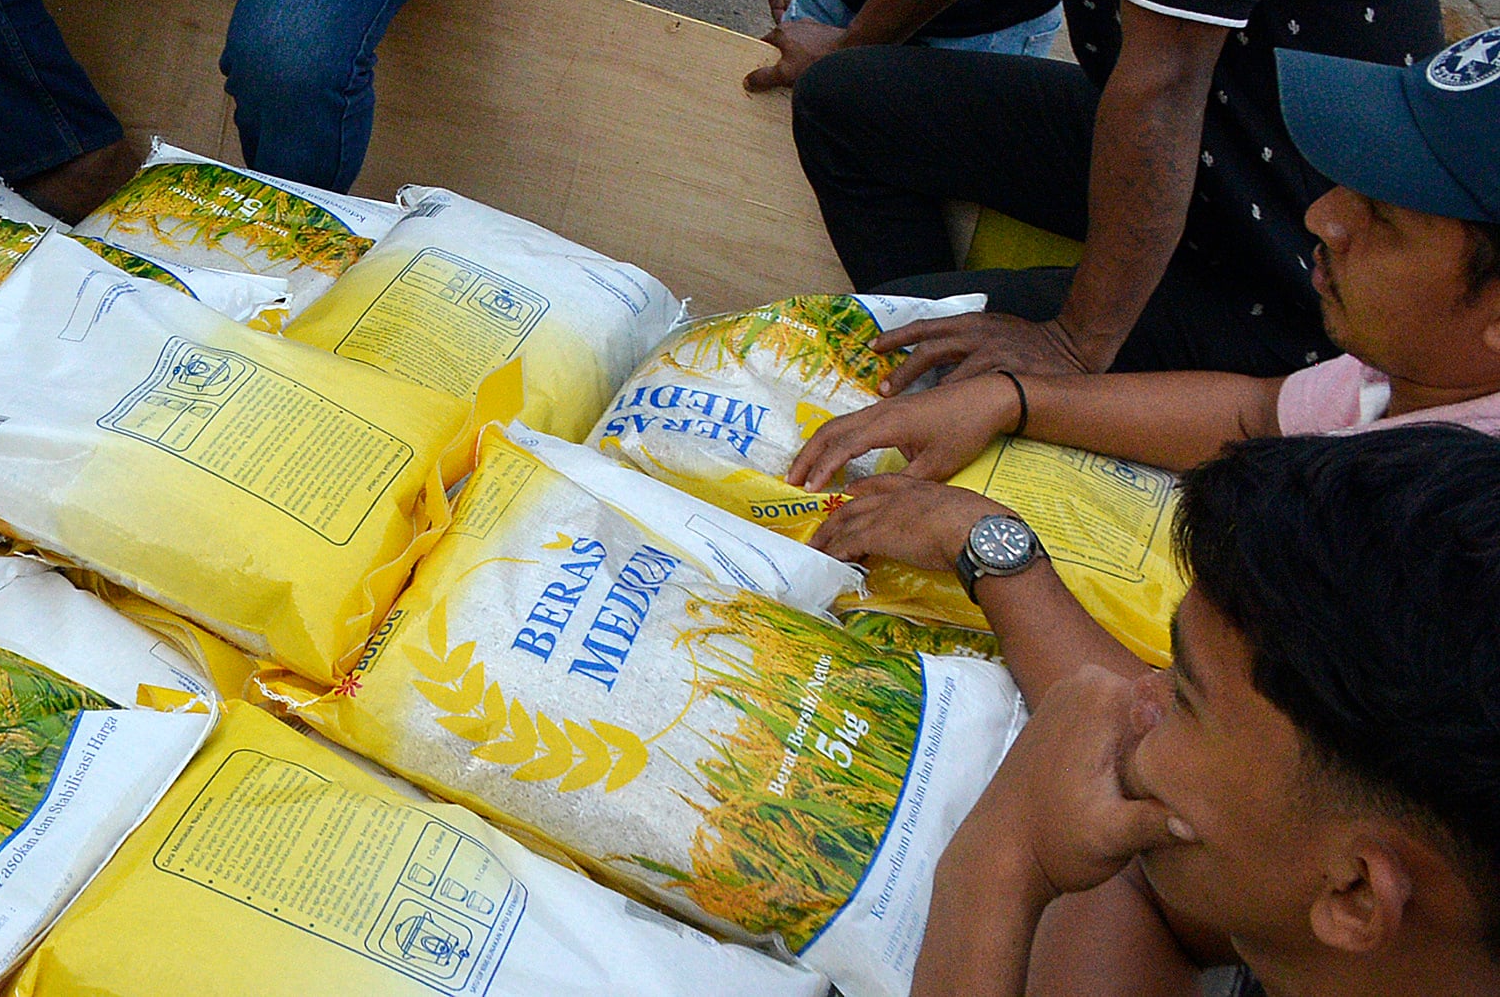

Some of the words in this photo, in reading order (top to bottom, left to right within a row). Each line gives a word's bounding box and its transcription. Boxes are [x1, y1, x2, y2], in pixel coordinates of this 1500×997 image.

[602, 411, 756, 459] BERAS
[613, 381, 770, 436] MEDI
[749, 501, 819, 517] BULOG
[509, 531, 610, 665] BERAS
[767, 746, 799, 797] Berat
[786, 651, 833, 748] Bersih/Netto:
[922, 704, 951, 761] Stabilisasi
[30, 810, 56, 838] dan
[47, 746, 97, 817] Stabilisasi
[86, 711, 120, 753] Harga
[916, 758, 935, 785] dan
[899, 783, 929, 835] Pasokan
[161, 851, 176, 869] Cara
[171, 823, 194, 854] Memasak
[869, 834, 911, 920] Ketersediaan
